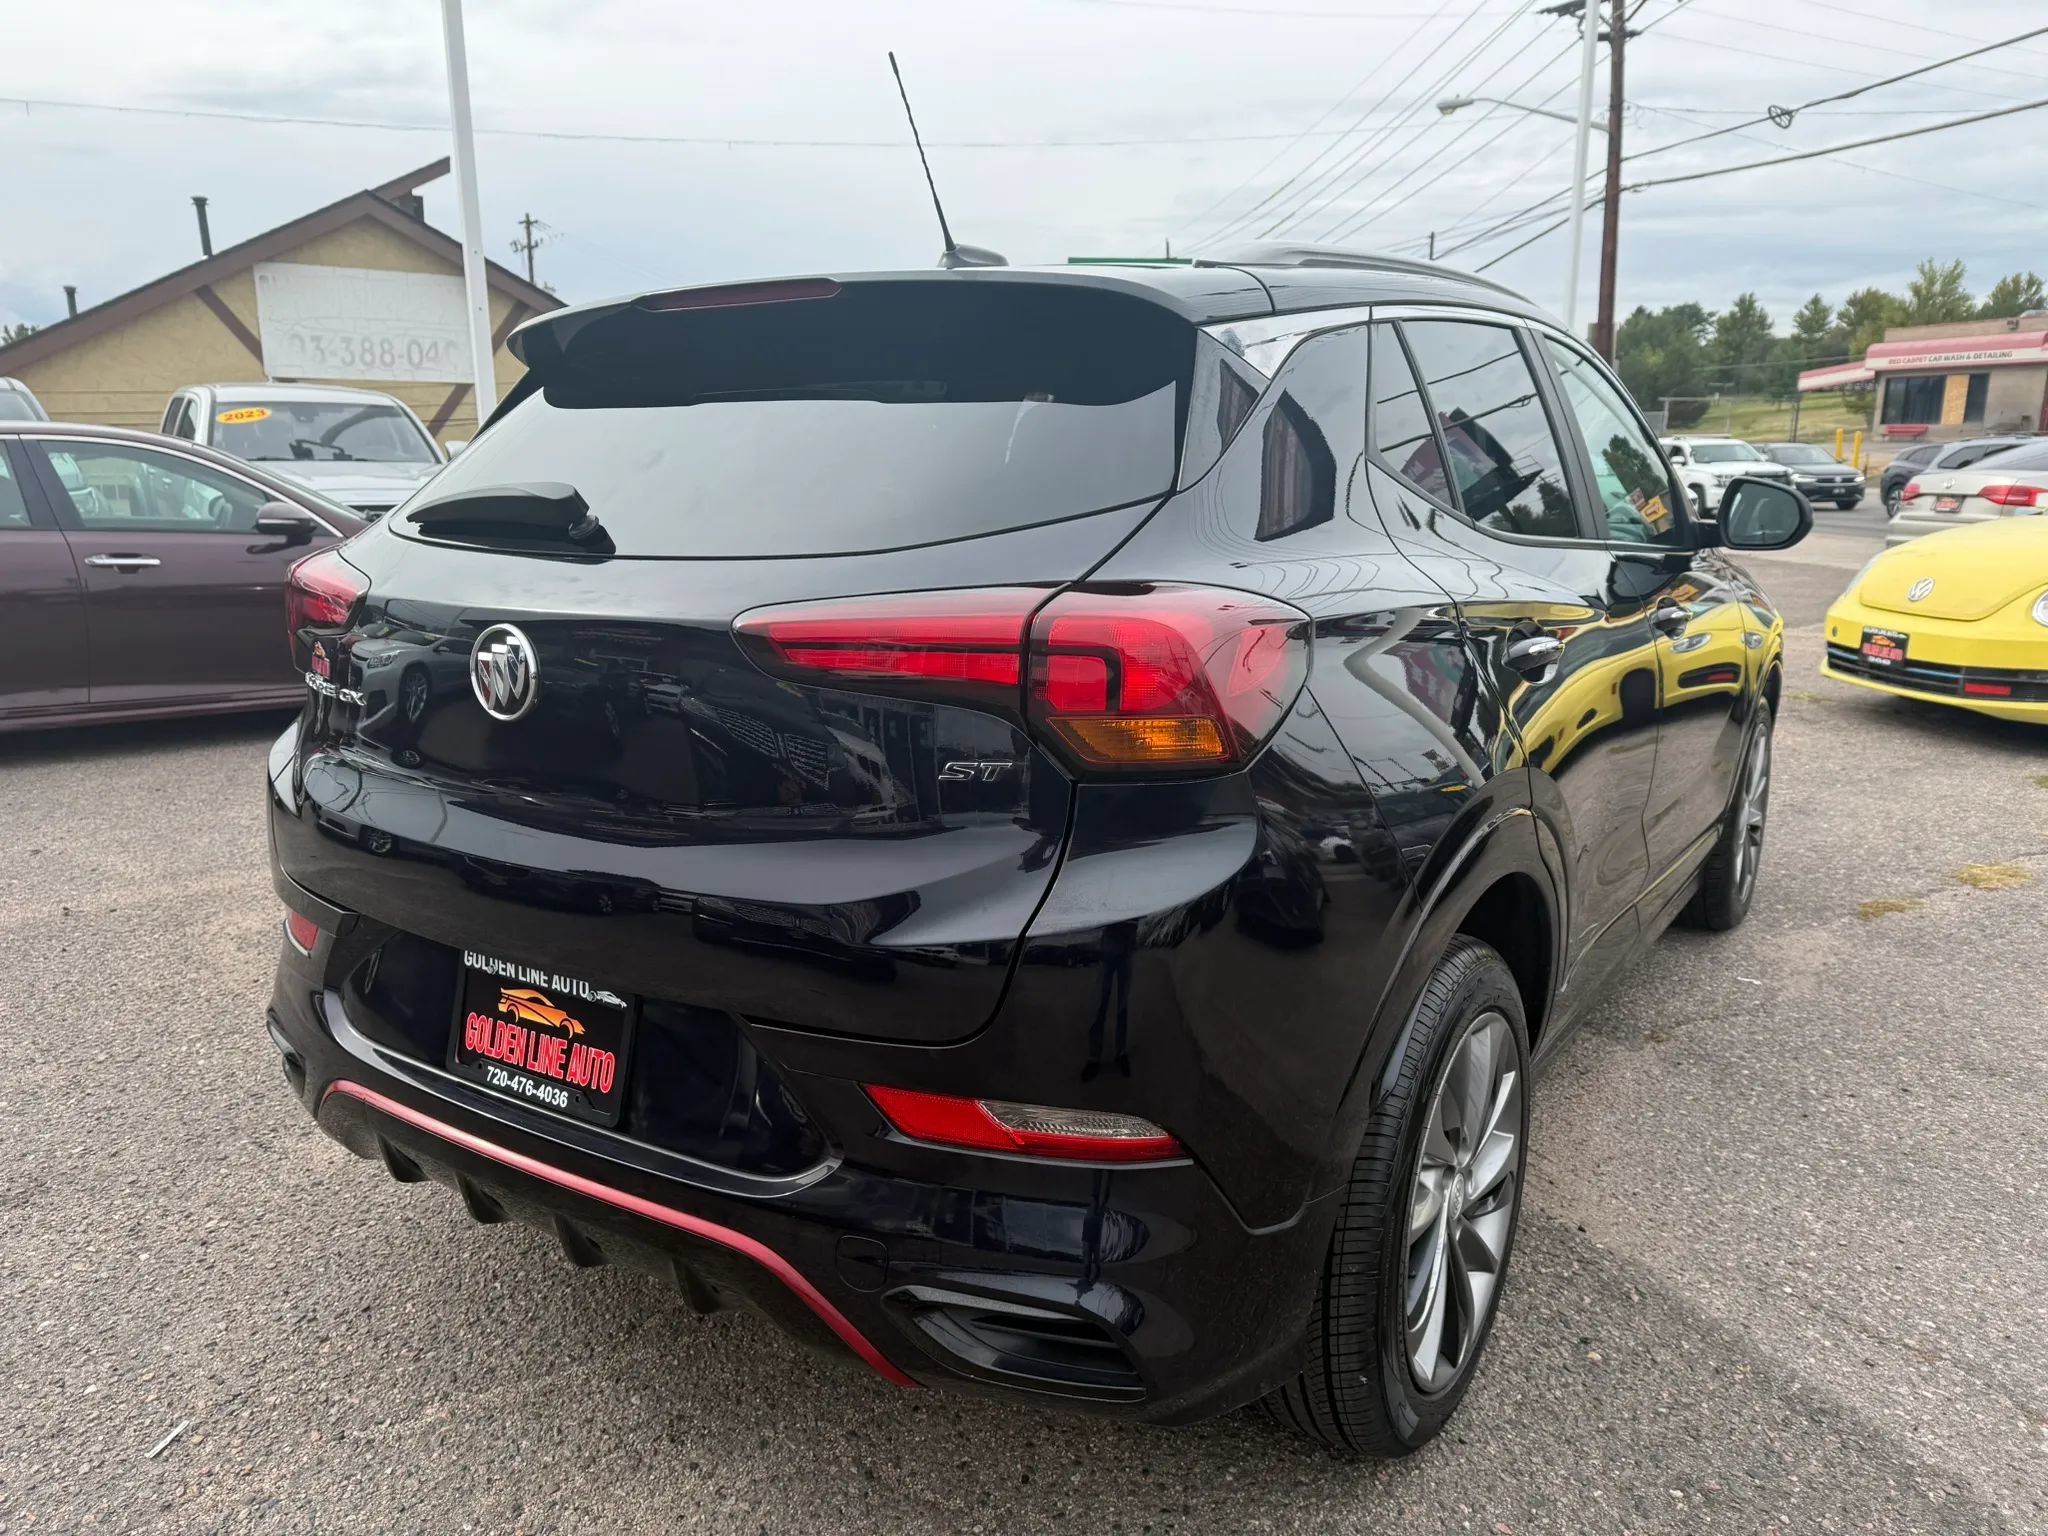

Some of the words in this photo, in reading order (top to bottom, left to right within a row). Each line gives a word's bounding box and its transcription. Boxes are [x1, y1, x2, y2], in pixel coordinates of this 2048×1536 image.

[1943, 353, 1965, 361] WASH
[1973, 351, 2013, 359] DETAILING
[223, 408, 267, 422] 2023
[938, 761, 1013, 782] ST
[464, 950, 516, 977] GOLDEN
[518, 966, 549, 988] LINE
[551, 974, 590, 998] AUTO
[465, 1012, 528, 1067] GOLDEN
[527, 1031, 568, 1079] LINE
[566, 1043, 616, 1094] AUTO
[485, 1065, 569, 1108] 720-476-4036
